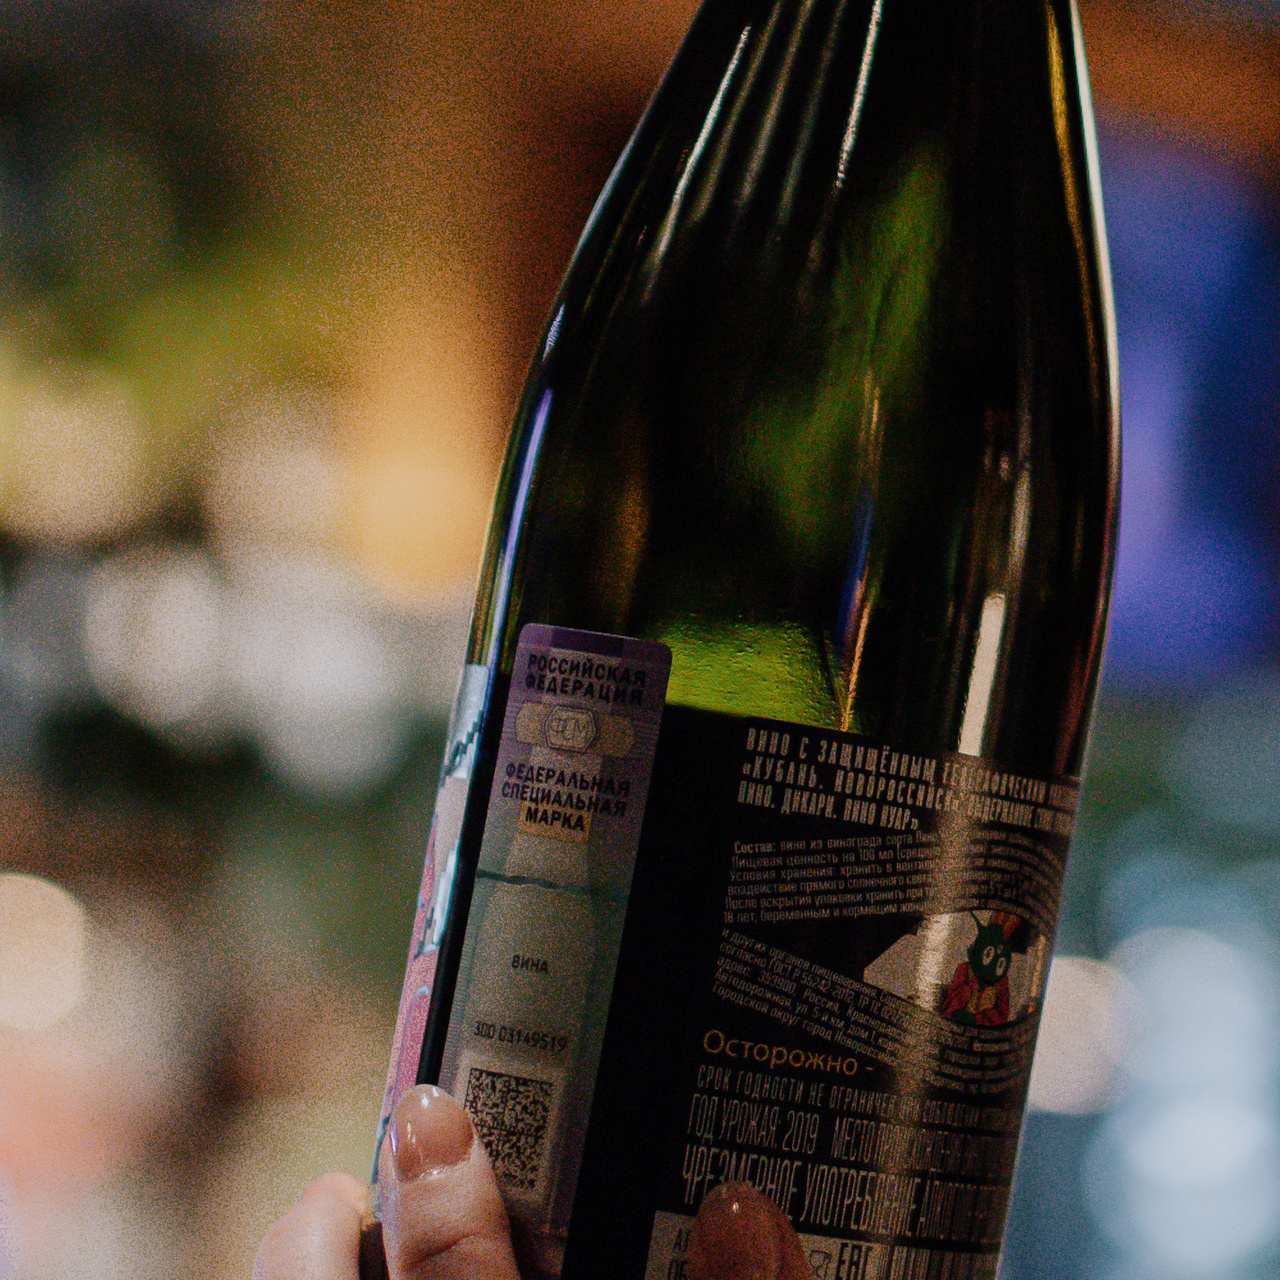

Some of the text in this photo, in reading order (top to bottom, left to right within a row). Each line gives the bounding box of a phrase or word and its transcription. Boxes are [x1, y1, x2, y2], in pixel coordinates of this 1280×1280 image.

[527, 654, 646, 687] РОССИЙСКАЯ
[525, 673, 643, 705] ФЕДЕРАЦИЯ
[746, 727, 790, 756] ВИНО
[799, 736, 809, 760] С
[818, 739, 936, 786] ЗАЩИЩЁННЫМ
[506, 762, 630, 797] ФЕДЕРАЛЬНАЯ
[502, 782, 626, 817] СПЕЦИАЛЬНАЯ
[843, 798, 876, 826] ПИНО
[525, 806, 584, 831] МАРКА
[732, 855, 783, 870] Пищевая
[787, 852, 839, 867] ценность
[842, 851, 855, 862] на
[859, 848, 875, 861] 100
[878, 848, 894, 860] мл
[734, 841, 776, 854] Состав:
[780, 840, 806, 851] вино
[810, 839, 823, 850] из
[827, 836, 883, 850] винограда
[886, 833, 913, 850] сорта
[727, 881, 798, 897] воздействие
[800, 879, 845, 893] прямого
[847, 875, 905, 888] солнечного
[729, 868, 776, 882] Условия
[840, 863, 883, 877] хранить
[886, 863, 893, 873] в
[724, 910, 734, 923] 18
[737, 910, 758, 924] лет,
[760, 907, 830, 923] беременным
[842, 903, 897, 918] кормящим
[725, 896, 757, 910] После
[760, 894, 812, 909] вскрытия
[814, 892, 863, 906] упаковки
[865, 888, 905, 902] хранить
[511, 954, 548, 974] ВИНА
[721, 928, 730, 938] и
[730, 932, 768, 954] других
[769, 945, 811, 971] органов
[720, 942, 767, 968] согласно
[769, 959, 792, 977] ГОСТ
[792, 968, 800, 980] Р
[857, 995, 870, 1008] ТР
[869, 1000, 881, 1015] ТС
[713, 980, 769, 1017] Городской
[770, 1007, 802, 1027] округ
[802, 1019, 831, 1041] город
[474, 1021, 567, 1052] 300 03149519
[847, 1024, 868, 1038] дом
[703, 1029, 858, 1076] Осторожно
[697, 1064, 732, 1092] СРОК
[736, 1070, 804, 1104] ГОДНОСТИ
[808, 1081, 825, 1108] НЕ
[829, 1085, 897, 1120] ОГРАНИЧЕН
[687, 1093, 719, 1145] ГОД
[782, 1110, 820, 1155] 2019
[830, 1116, 876, 1163] МЕСТО
